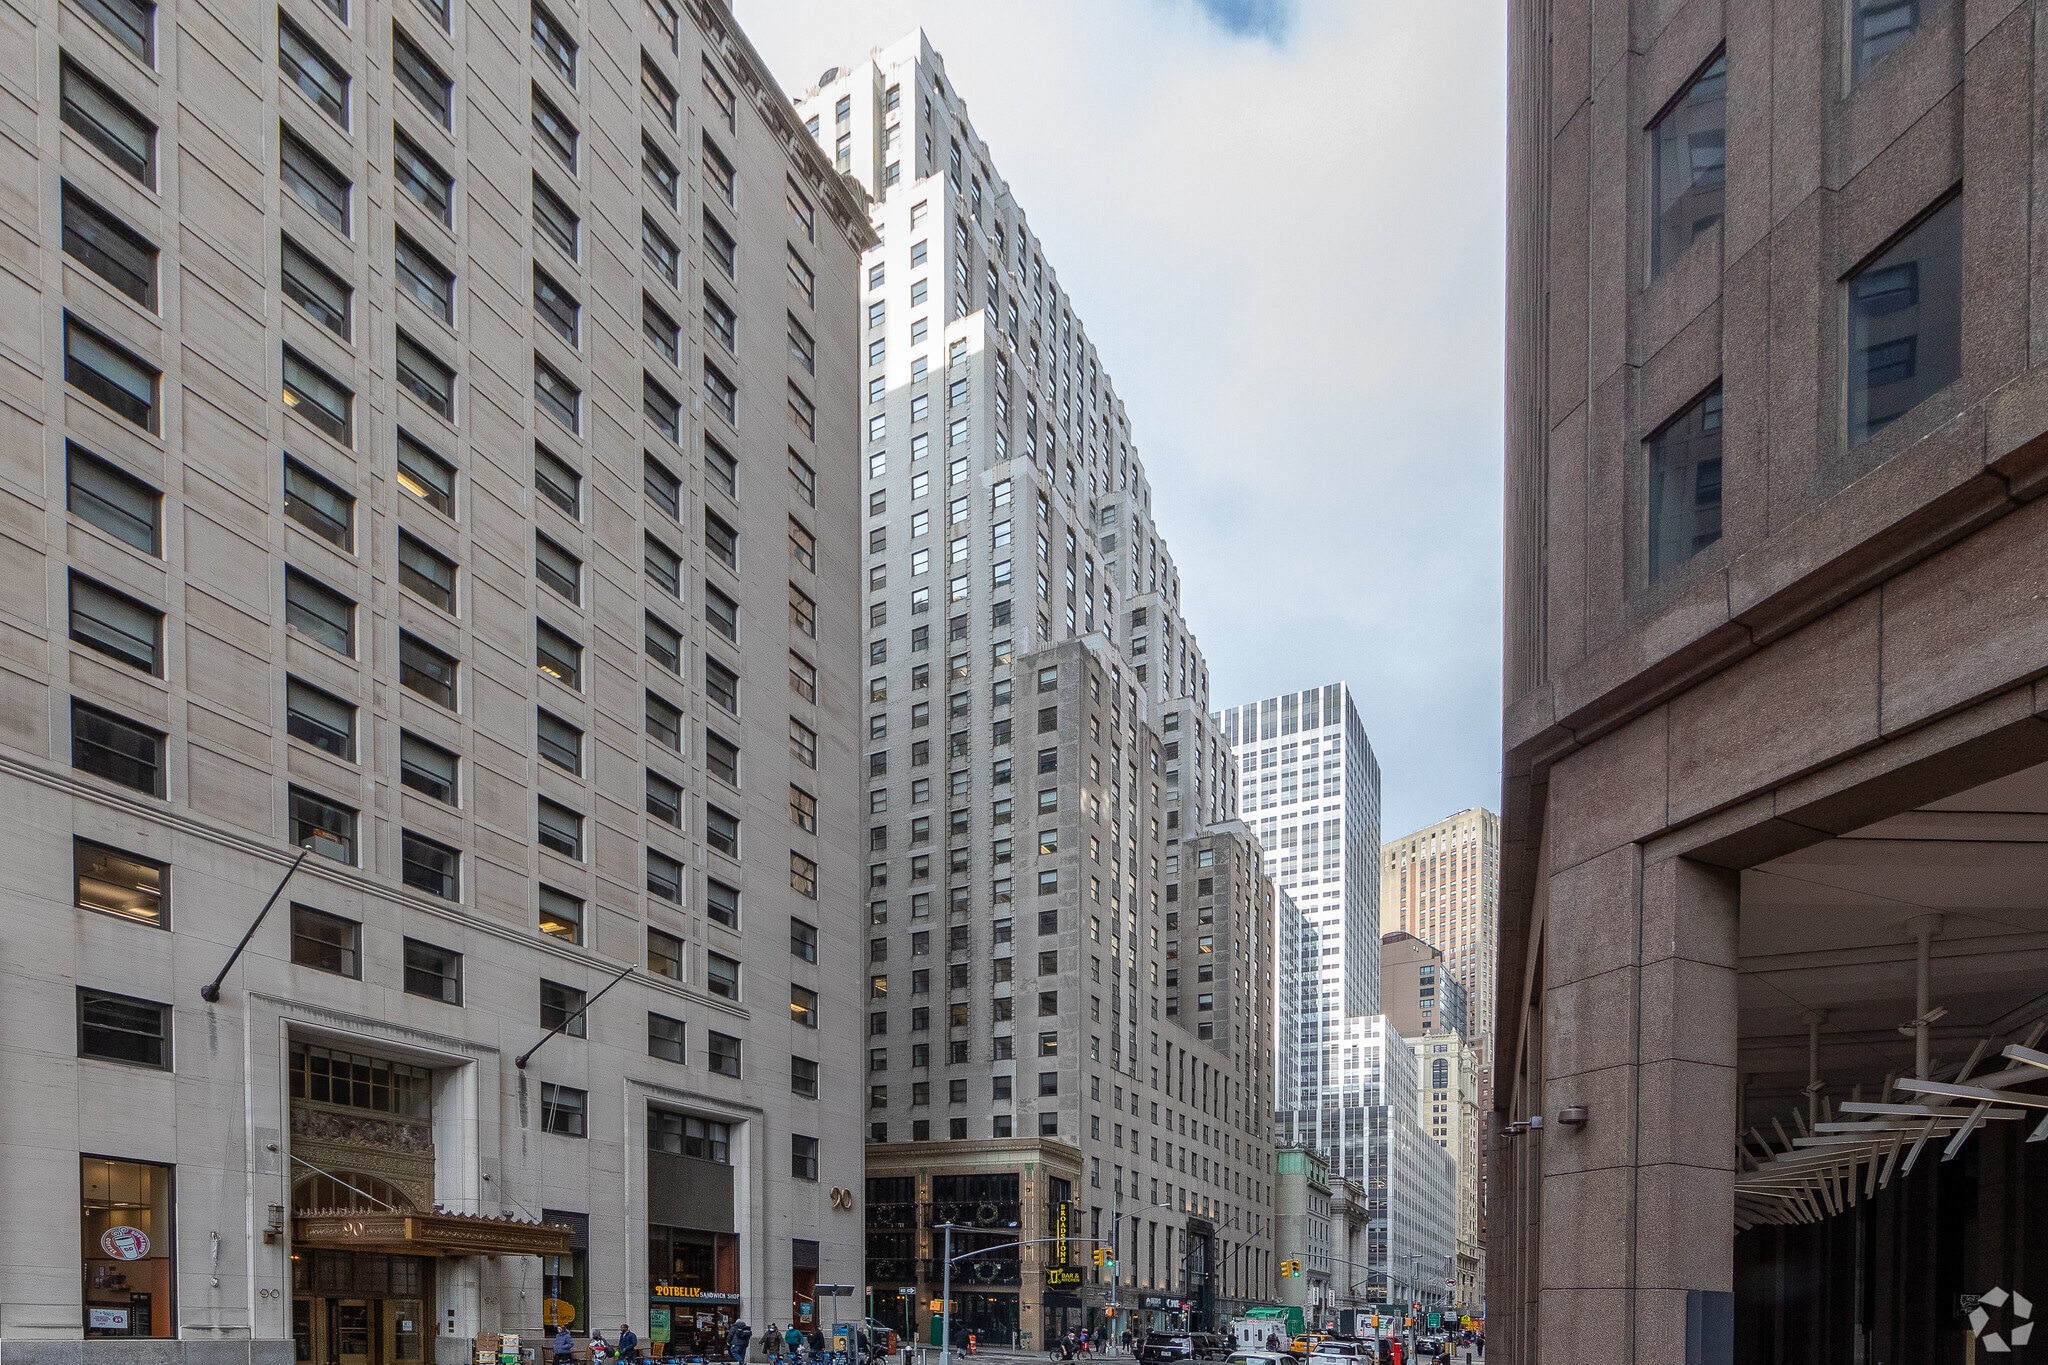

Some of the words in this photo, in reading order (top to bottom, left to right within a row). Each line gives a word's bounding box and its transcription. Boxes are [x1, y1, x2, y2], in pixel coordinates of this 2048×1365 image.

[830, 1186, 852, 1209] 90
[344, 1222, 363, 1237] 90
[259, 1288, 280, 1299] 90
[655, 1286, 700, 1297] POTBELLY
[700, 1291, 726, 1299] SANDWICH
[1361, 1320, 1391, 1330] FeEx
